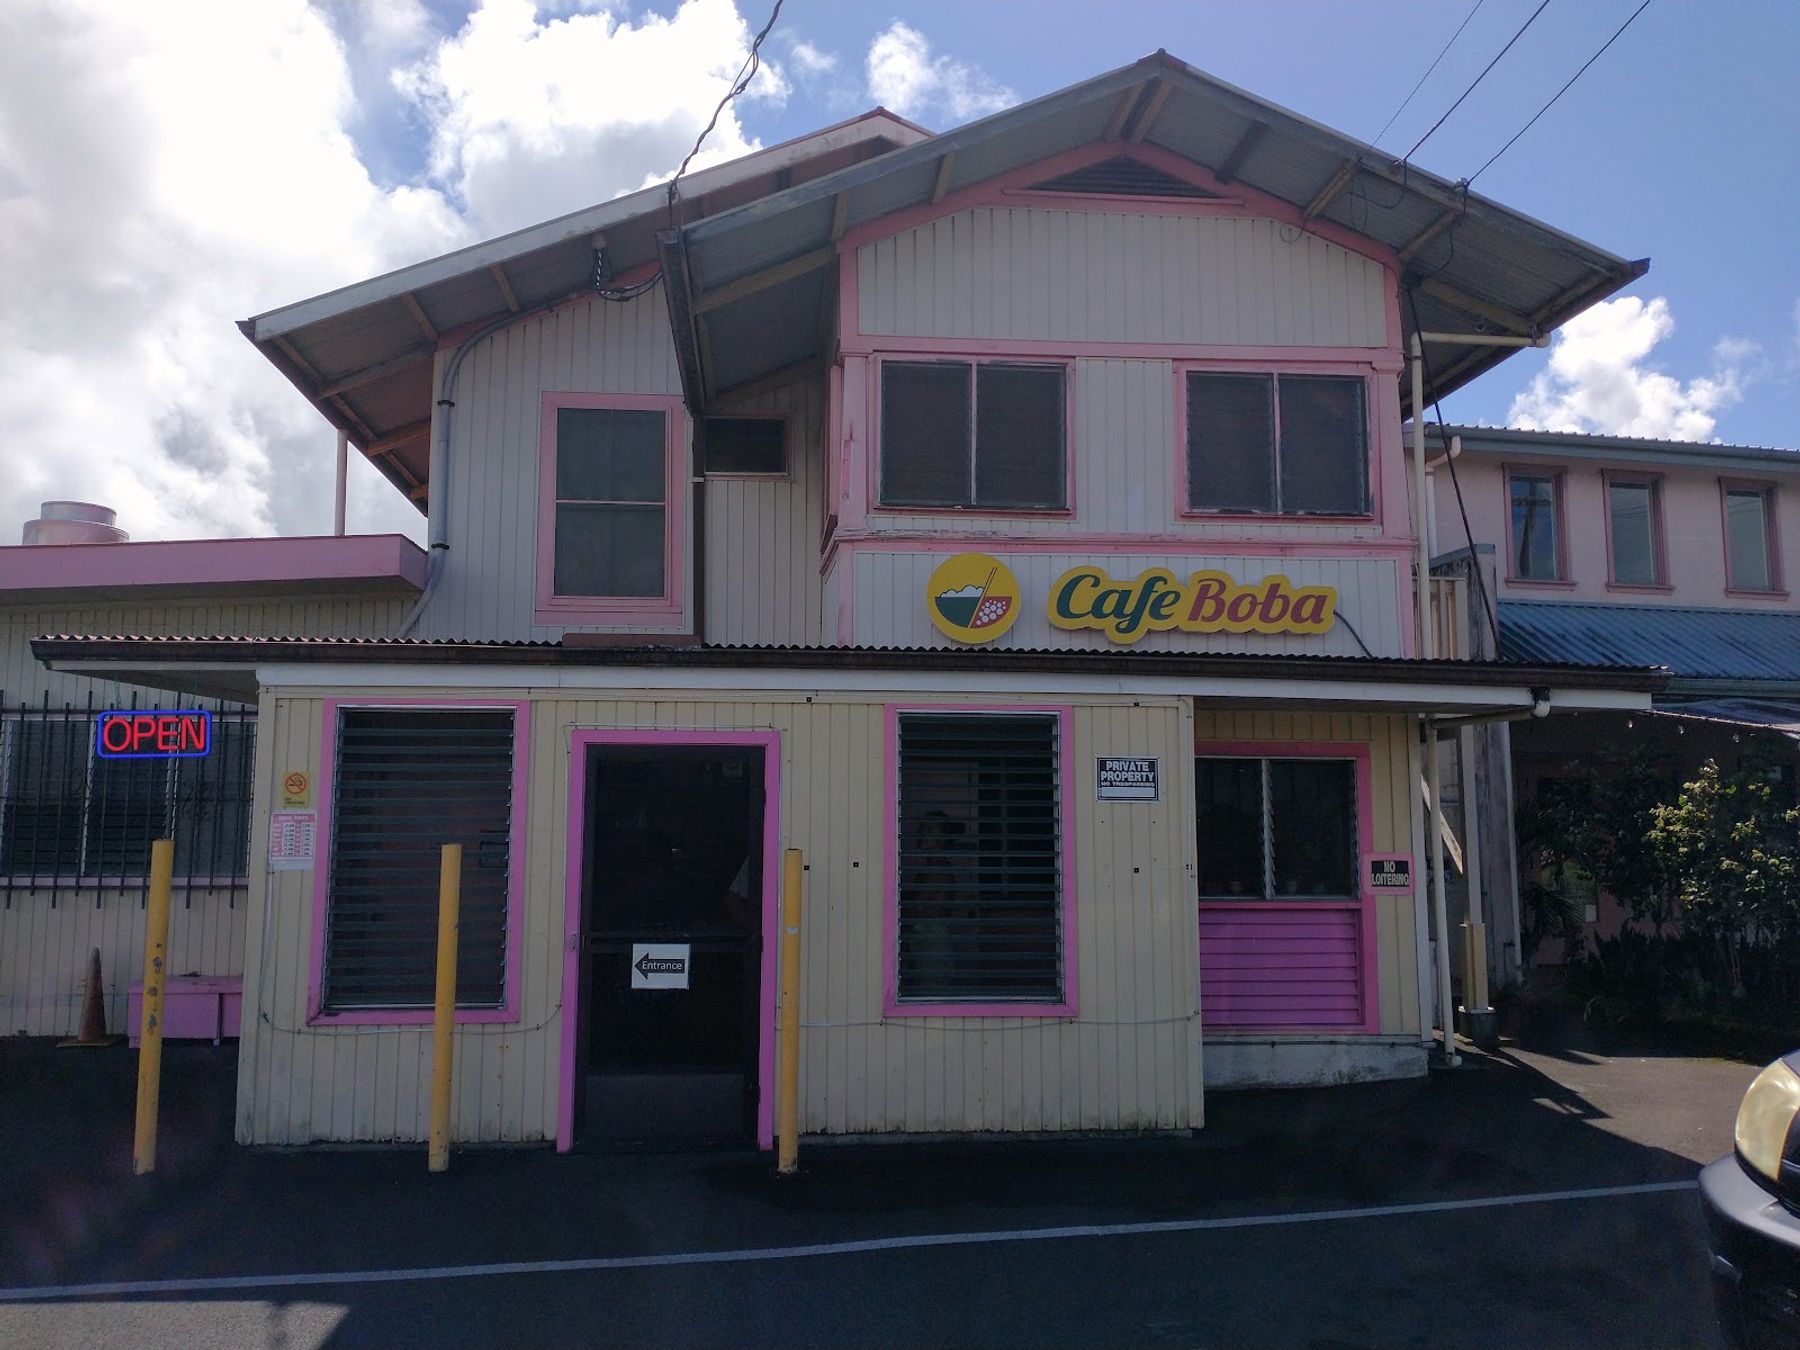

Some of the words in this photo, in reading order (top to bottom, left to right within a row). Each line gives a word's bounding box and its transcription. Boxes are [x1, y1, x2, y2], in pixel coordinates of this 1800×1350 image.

[1056, 573, 1180, 634] Cafe
[1186, 577, 1329, 625] Boba
[103, 716, 206, 752] OPEN
[1105, 760, 1149, 772] PRIVATE
[1101, 771, 1154, 782] PROPERTY
[1383, 860, 1396, 873] NO
[1371, 873, 1409, 886] LOITERING
[642, 960, 682, 970] Entrance
